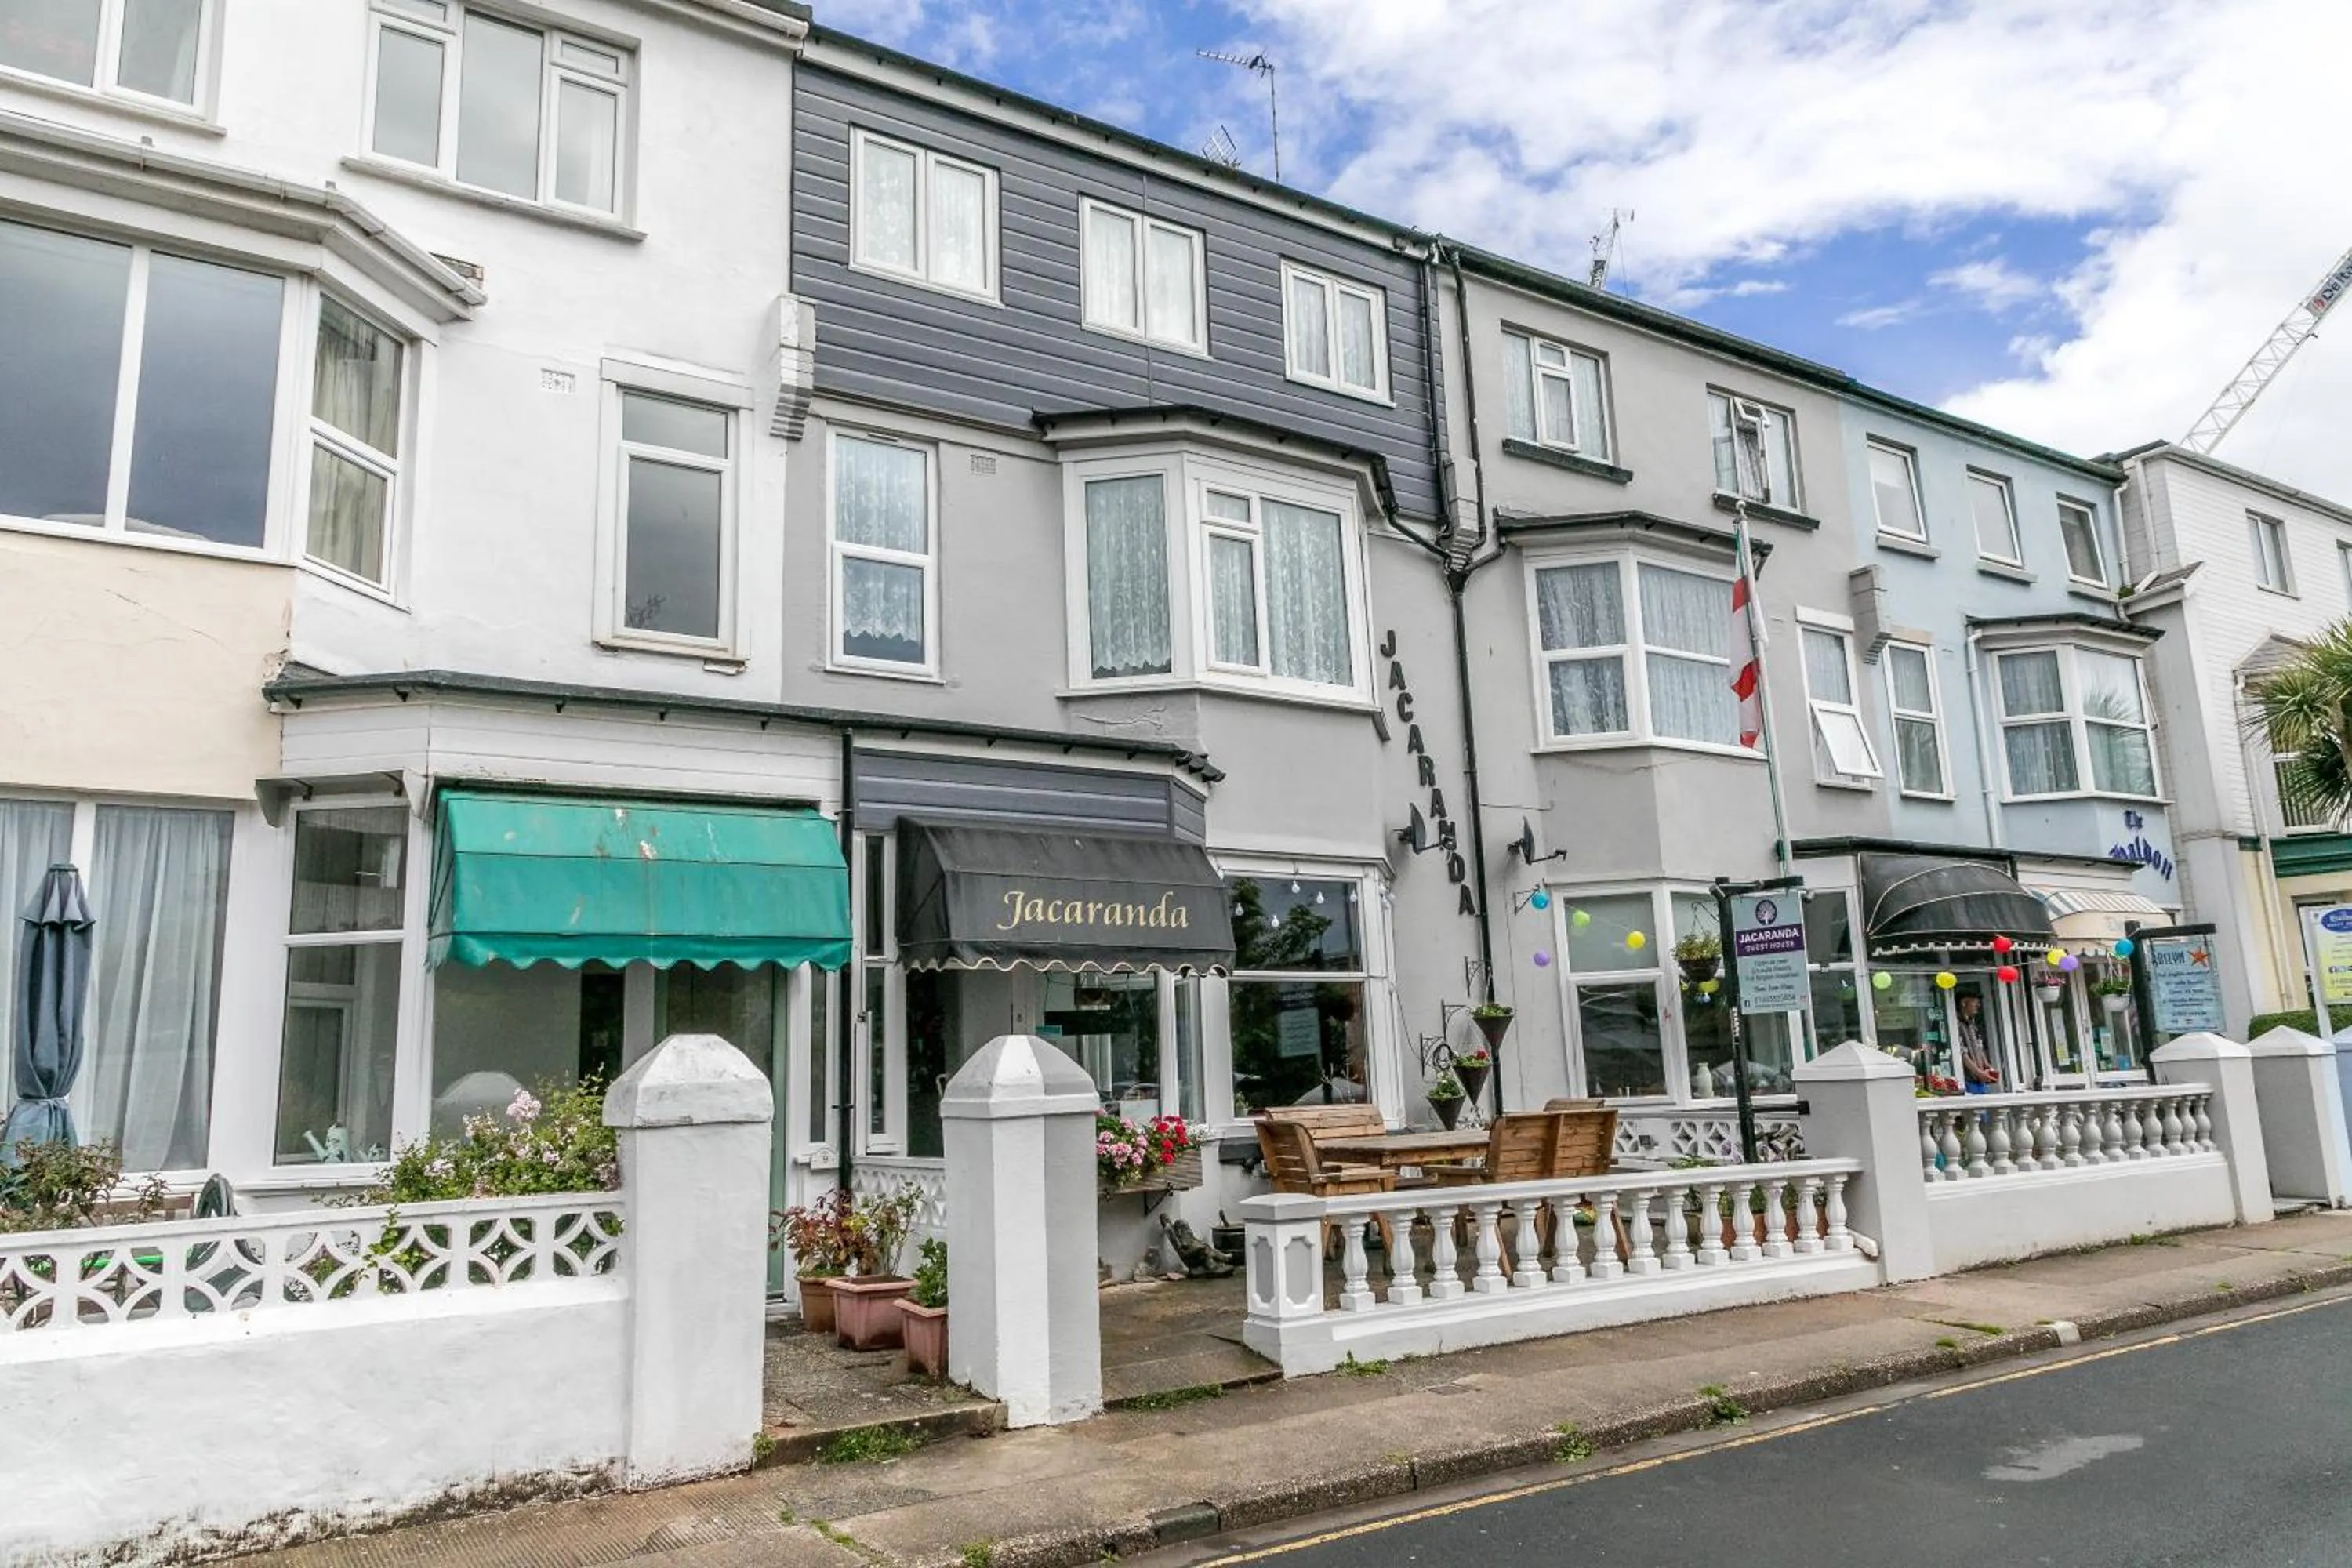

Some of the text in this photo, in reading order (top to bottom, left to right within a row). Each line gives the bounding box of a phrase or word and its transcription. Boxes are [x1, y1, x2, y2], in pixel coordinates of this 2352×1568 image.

[1380, 630, 1475, 916] JACARANDA
[996, 890, 1189, 931] Jacaranda
[1739, 927, 1800, 943] JACARANDA
[1745, 940, 1795, 952] GUEST HOUSE
